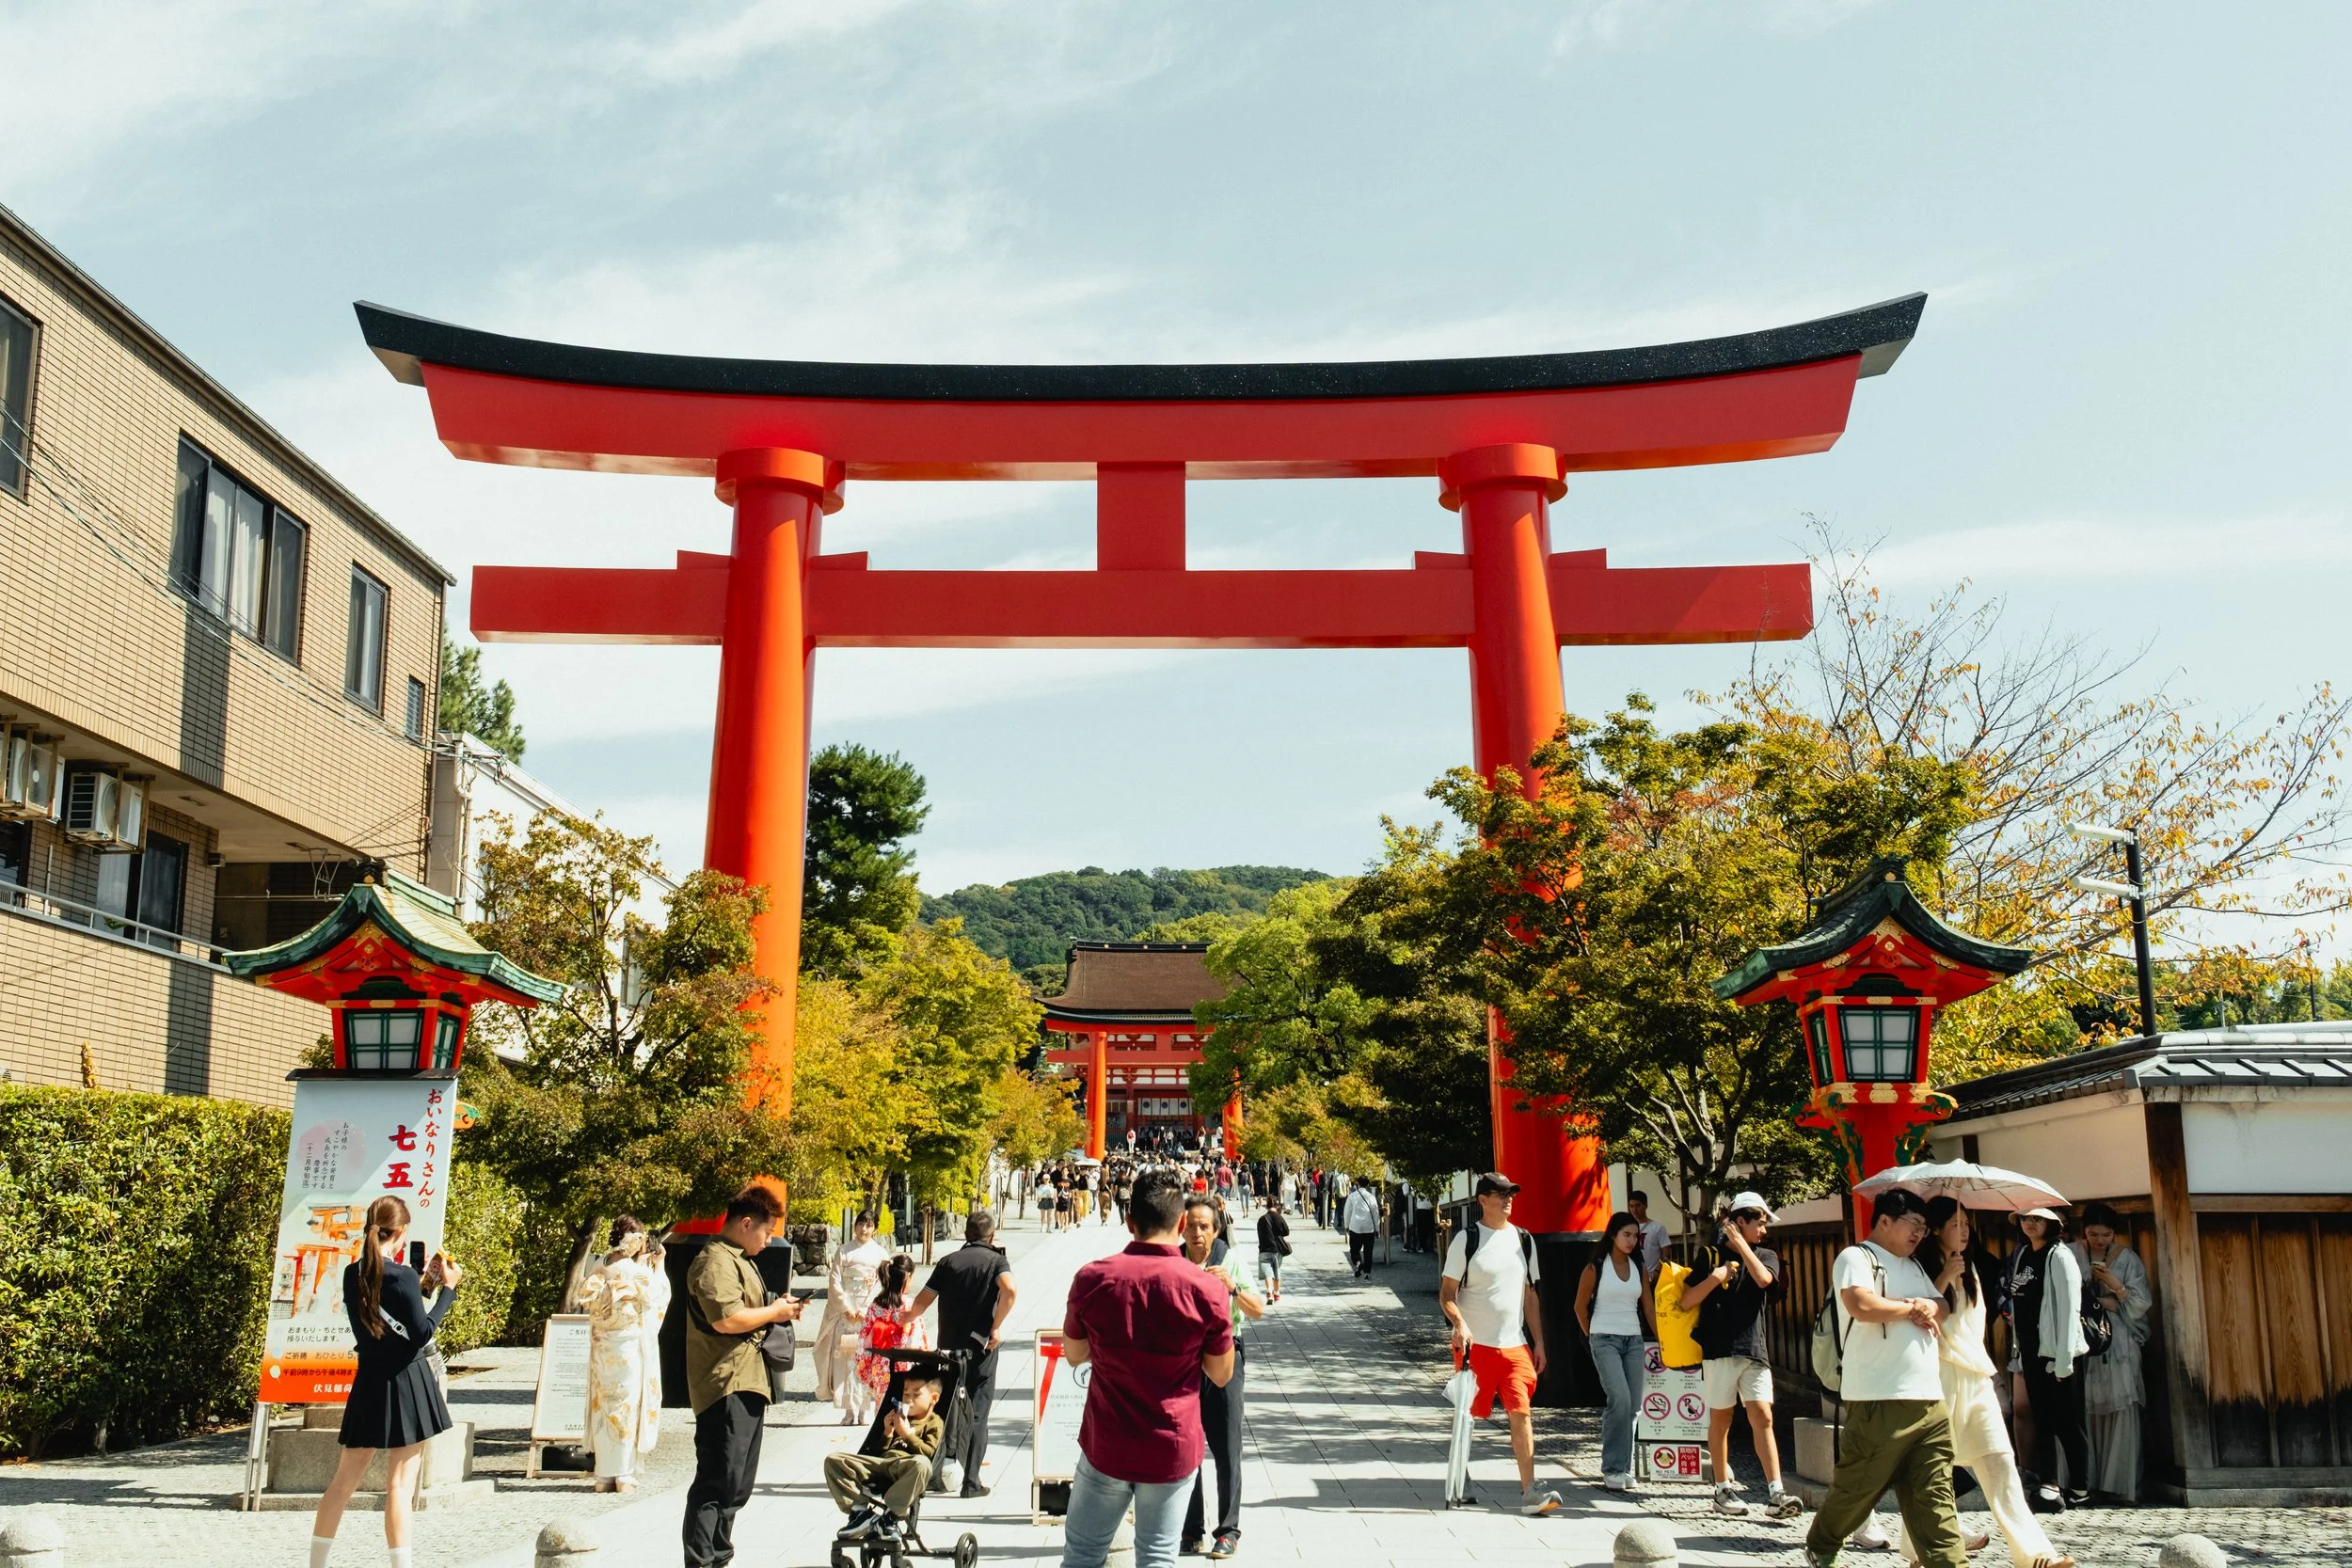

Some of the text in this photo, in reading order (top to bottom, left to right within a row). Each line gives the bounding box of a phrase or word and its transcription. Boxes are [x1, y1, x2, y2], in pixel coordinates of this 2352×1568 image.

[341, 1122, 349, 1150] お子様の
[418, 1088, 442, 1209] おいなりさんの
[314, 1352, 344, 1360] おひとり
